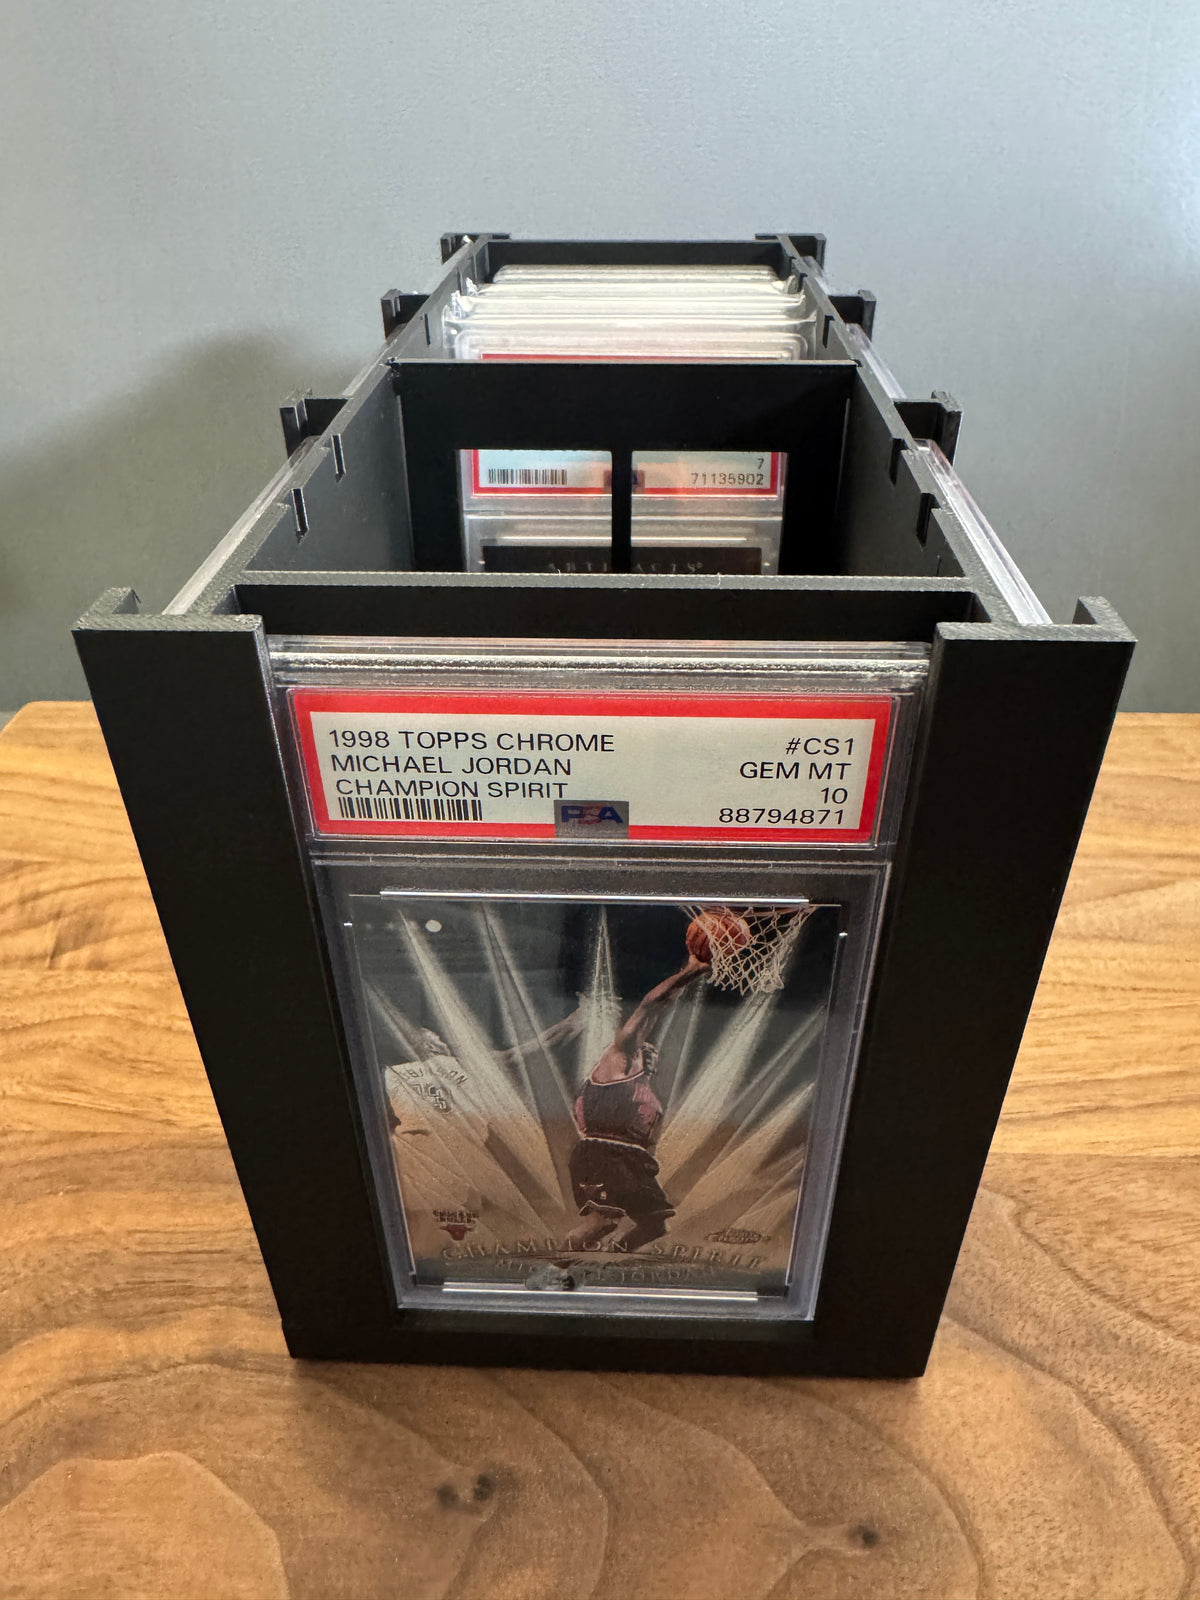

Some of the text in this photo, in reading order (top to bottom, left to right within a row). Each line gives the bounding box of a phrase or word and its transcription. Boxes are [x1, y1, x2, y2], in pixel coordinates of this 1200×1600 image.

[756, 457, 765, 470] 7
[690, 472, 764, 486] 71135902
[328, 729, 615, 752] 1998 TOPPS CHROME
[785, 737, 854, 756] #CS1
[330, 754, 572, 776] MICHAEL JORDAN
[739, 761, 852, 780] GEM MT
[335, 778, 568, 799] CHAMPION SPIRIT
[820, 787, 849, 805] 10
[561, 804, 624, 824] PSA
[718, 807, 844, 825] 88794871
